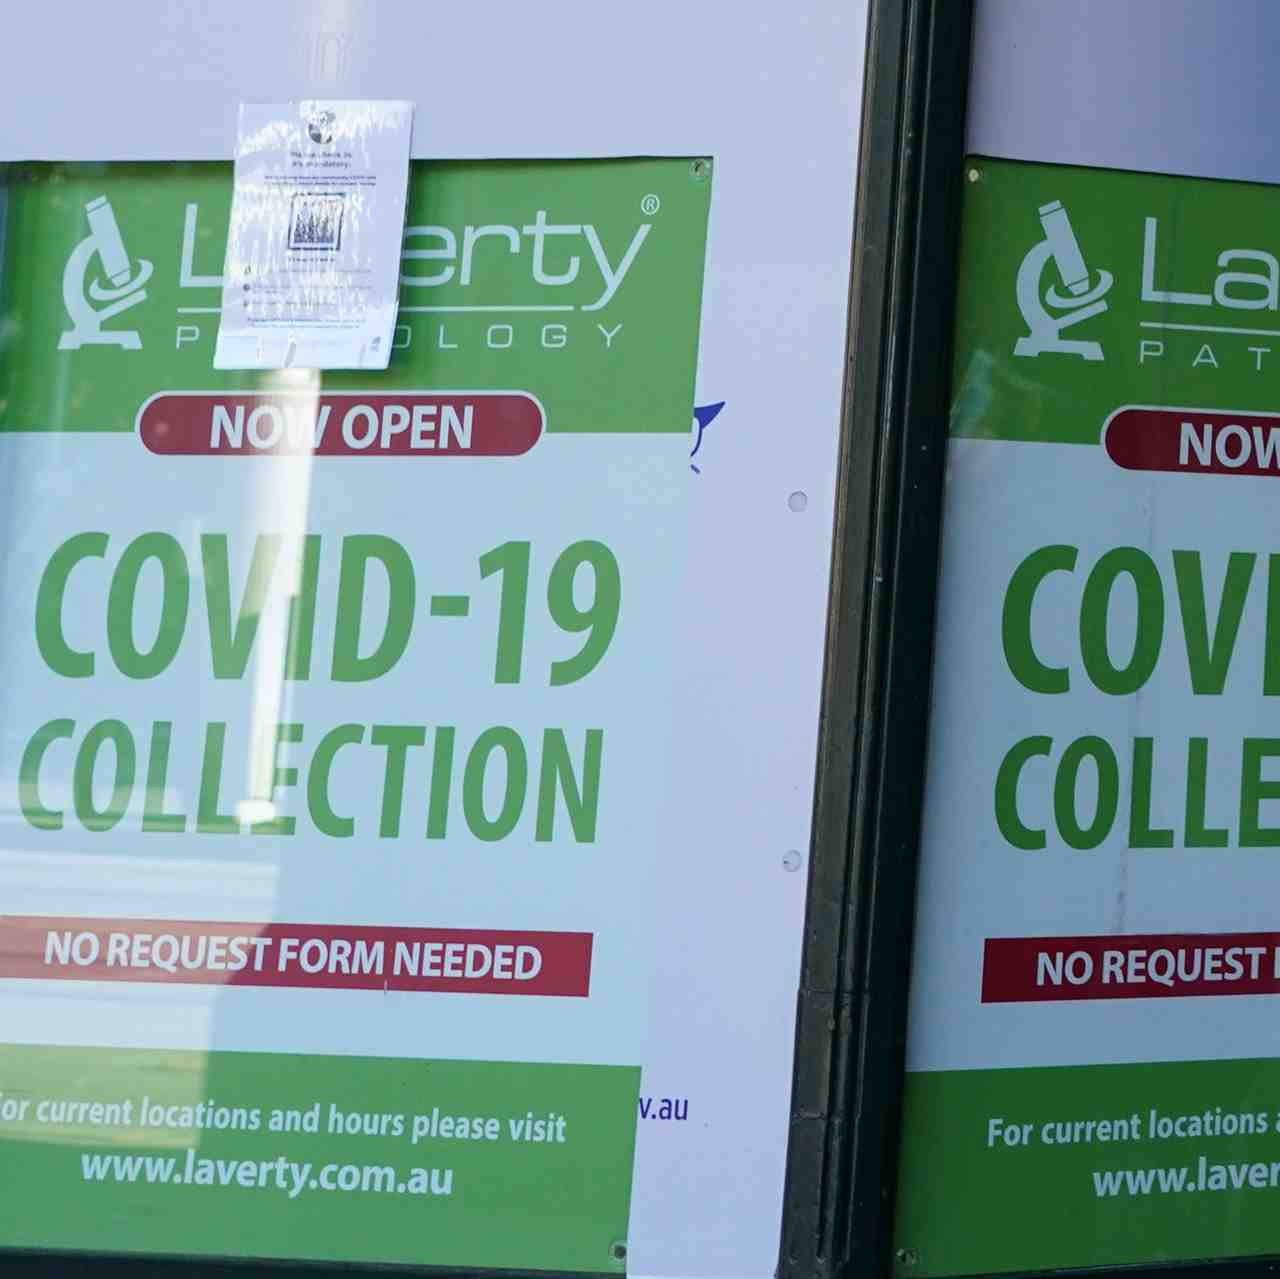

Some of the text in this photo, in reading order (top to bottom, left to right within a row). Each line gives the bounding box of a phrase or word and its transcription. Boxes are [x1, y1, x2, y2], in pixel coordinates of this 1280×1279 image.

[179, 203, 652, 312] Lerty
[176, 323, 625, 351] POLOGY
[209, 404, 474, 450] NOW OPEN
[34, 530, 622, 687] COVID-19
[17, 717, 603, 843] COLLECTION
[44, 931, 542, 980] NO REQUEST FORM NEEDED
[1036, 951, 1094, 985] NO
[1102, 946, 1266, 988] REQUEST
[0, 1093, 567, 1144] or current locations and hours please visit
[987, 1117, 1033, 1148] For
[1041, 1112, 1141, 1144] current
[1149, 1104, 1268, 1139] locations
[81, 1149, 454, 1197] www.laverty.com.au
